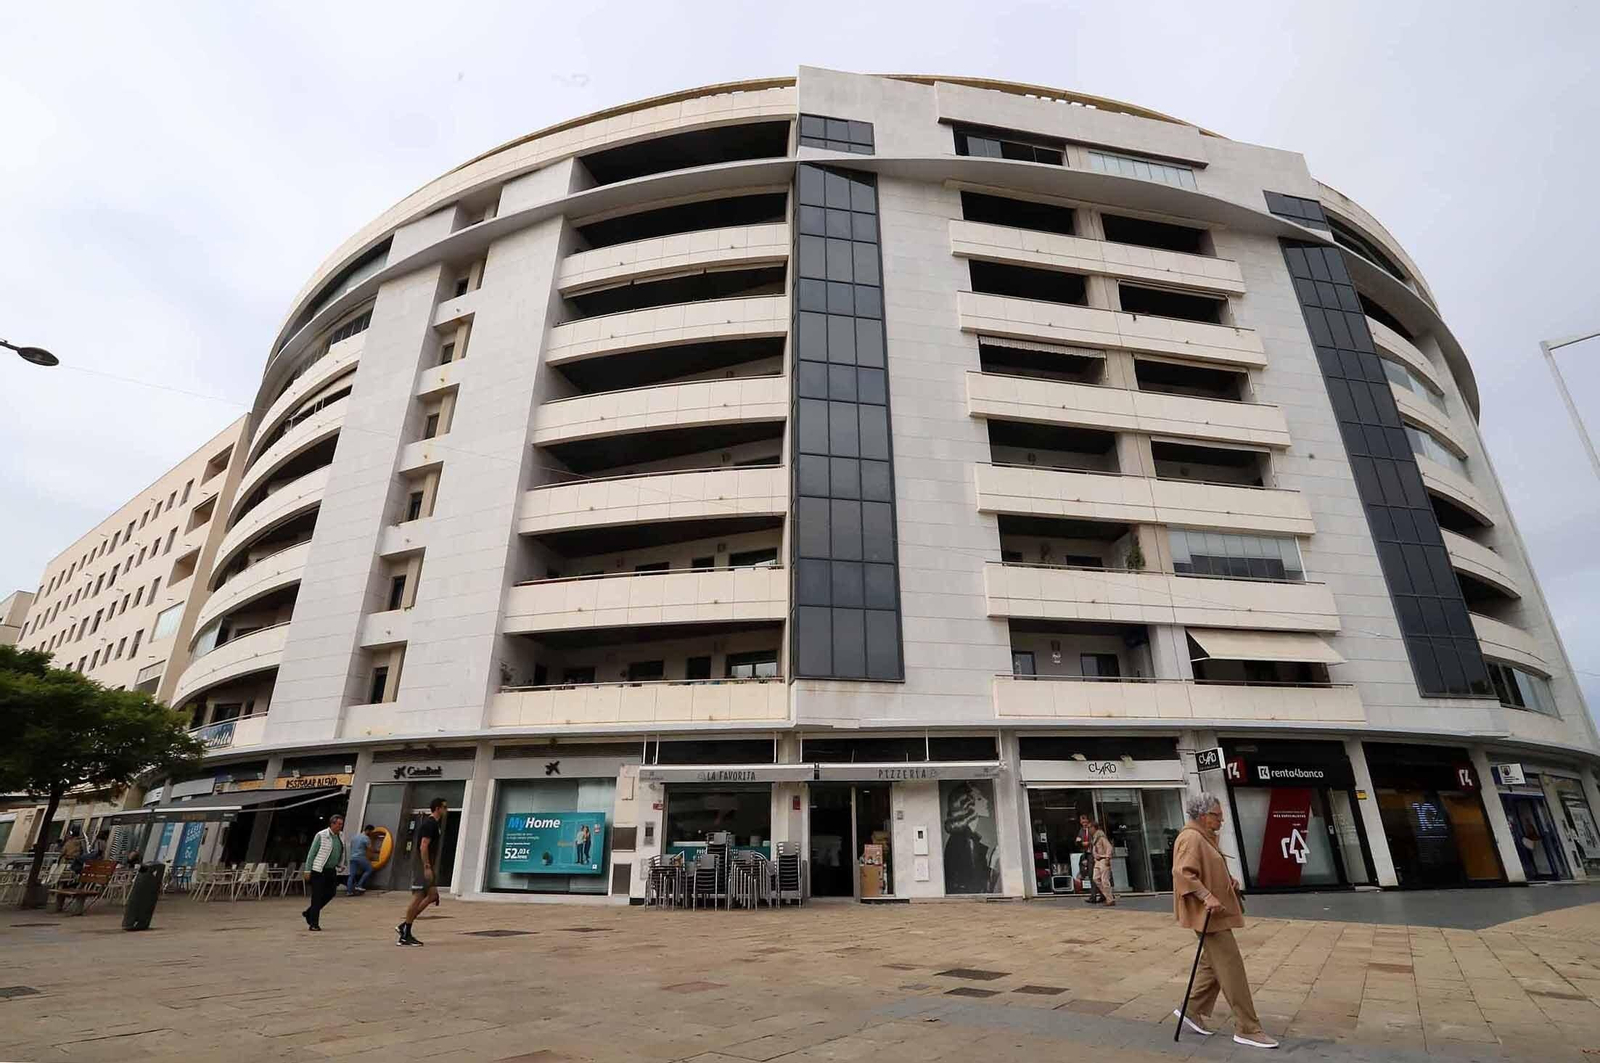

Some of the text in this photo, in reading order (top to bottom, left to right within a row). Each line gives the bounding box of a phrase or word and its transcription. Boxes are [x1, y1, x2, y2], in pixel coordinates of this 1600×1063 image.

[1088, 762, 1117, 775] CLARO
[1271, 768, 1324, 778] renta4banco
[707, 771, 756, 781] LA FAVORITA
[508, 817, 560, 831] MyHome
